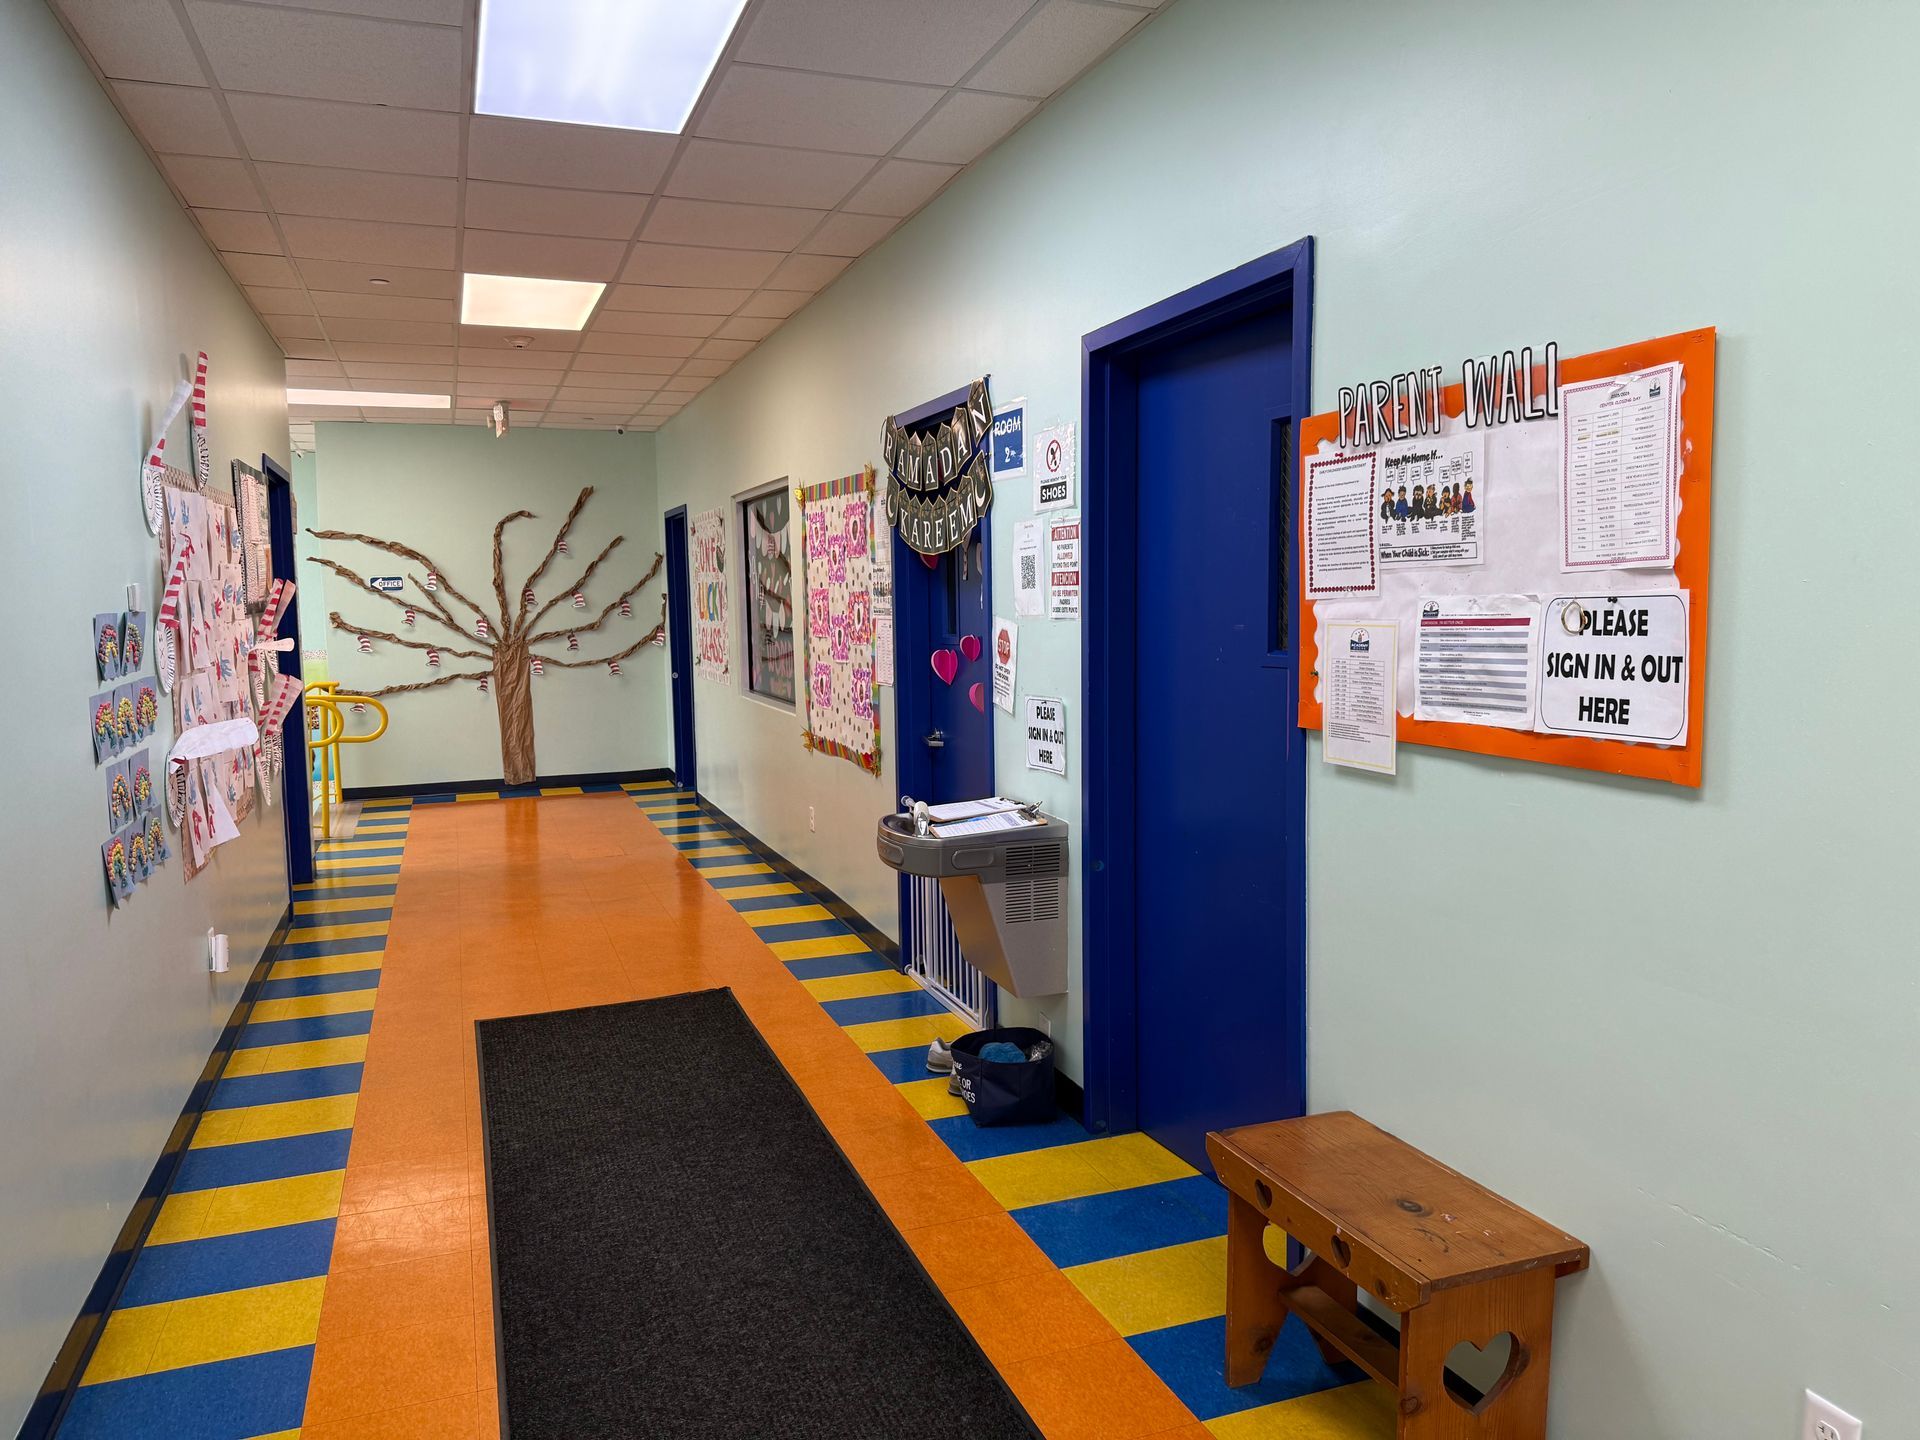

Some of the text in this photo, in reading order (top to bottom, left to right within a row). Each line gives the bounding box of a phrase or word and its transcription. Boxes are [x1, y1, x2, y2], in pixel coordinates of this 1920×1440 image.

[1338, 365, 1442, 448] PARENT
[1463, 341, 1558, 428] WALL
[994, 415, 1021, 436] ROOM
[884, 394, 987, 484] RAMADAN
[1385, 457, 1400, 469] Keep
[1401, 454, 1410, 465] Me
[1411, 453, 1430, 464] Home
[1042, 485, 1066, 500] SHOES
[899, 494, 974, 549] KAREEM
[1054, 528, 1076, 539] ATTENTION
[699, 537, 716, 573] ONE
[1057, 551, 1073, 560] ALLOWED
[1392, 550, 1401, 558] Your
[1402, 548, 1413, 557] Child
[699, 581, 724, 622] LUCKY
[1578, 608, 1649, 637] PLEASE
[701, 626, 724, 664] CLASS
[998, 639, 1010, 655] STOP
[1546, 652, 1684, 684] SIGN IN & OUT
[1036, 705, 1055, 721] PLEASE
[1578, 696, 1630, 725] HERE
[1028, 726, 1064, 744] SIGN IN & OUT
[1039, 748, 1053, 764] HERE
[961, 1077, 971, 1090] OR
